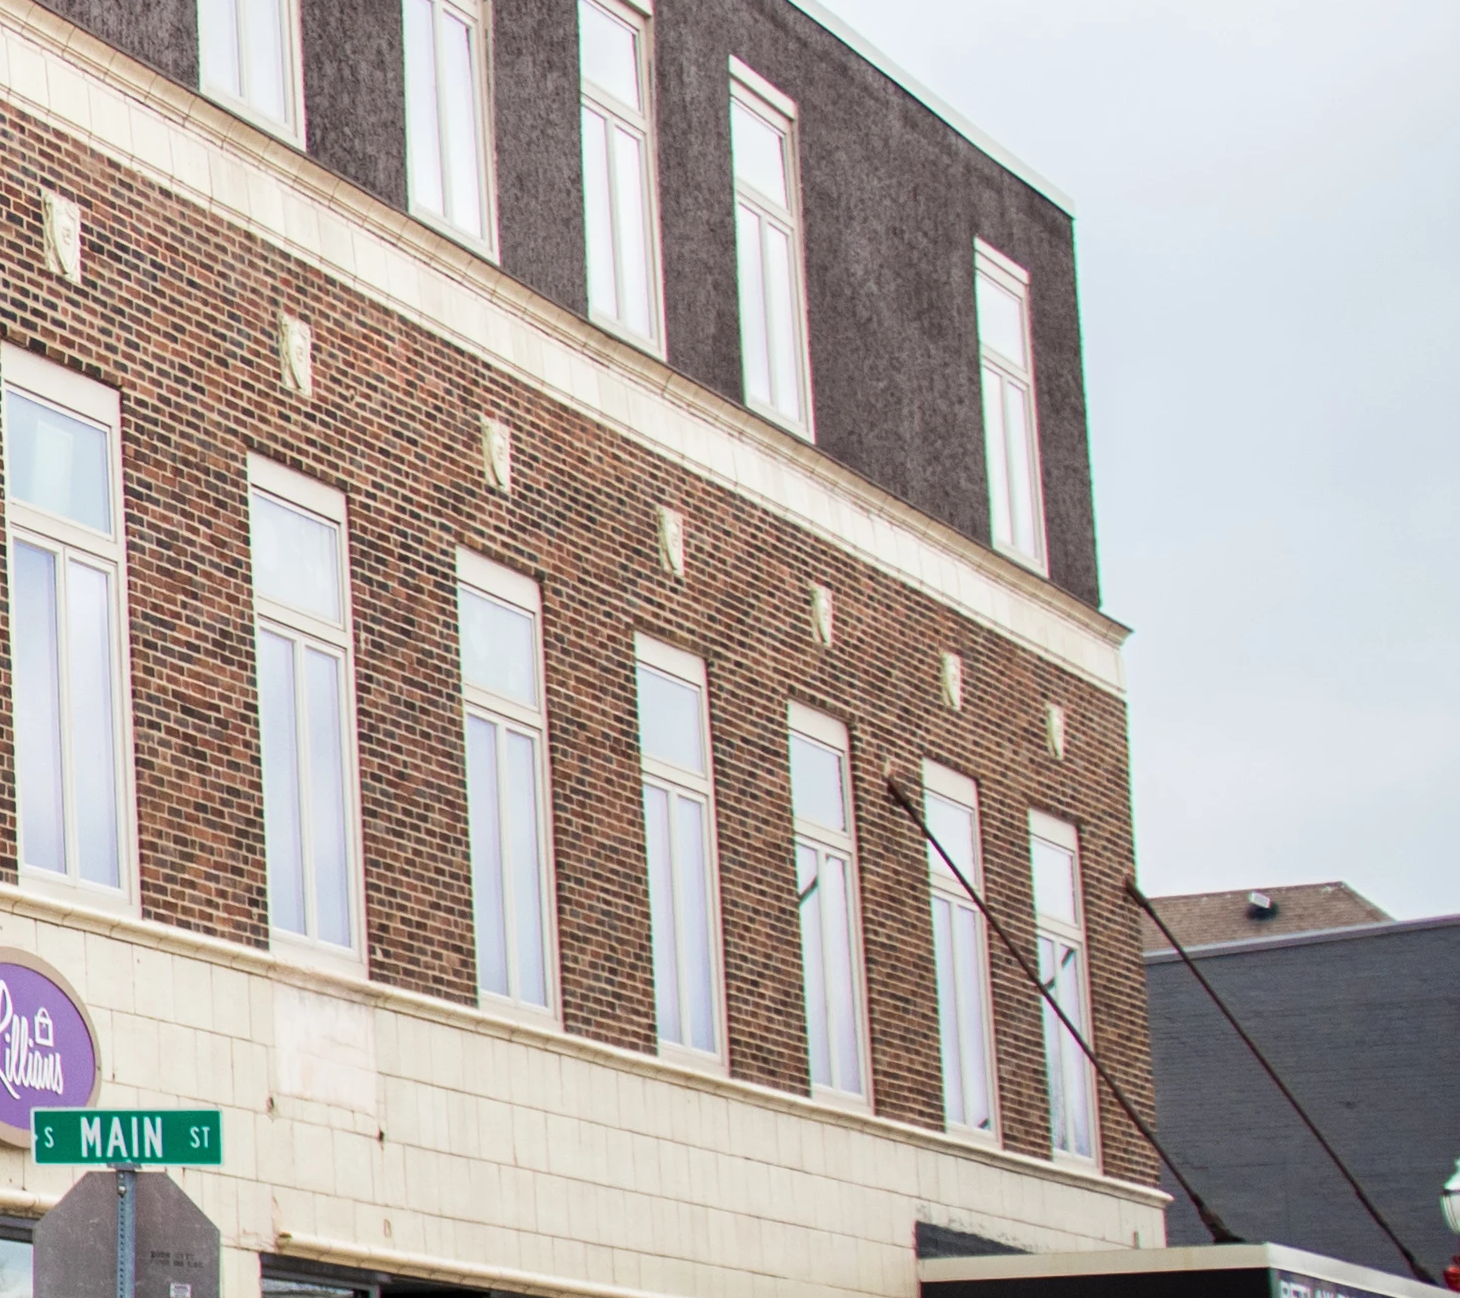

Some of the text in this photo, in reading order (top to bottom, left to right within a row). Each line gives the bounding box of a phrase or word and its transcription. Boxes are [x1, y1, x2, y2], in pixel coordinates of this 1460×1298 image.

[44, 1116, 211, 1159] S MAIN ST
